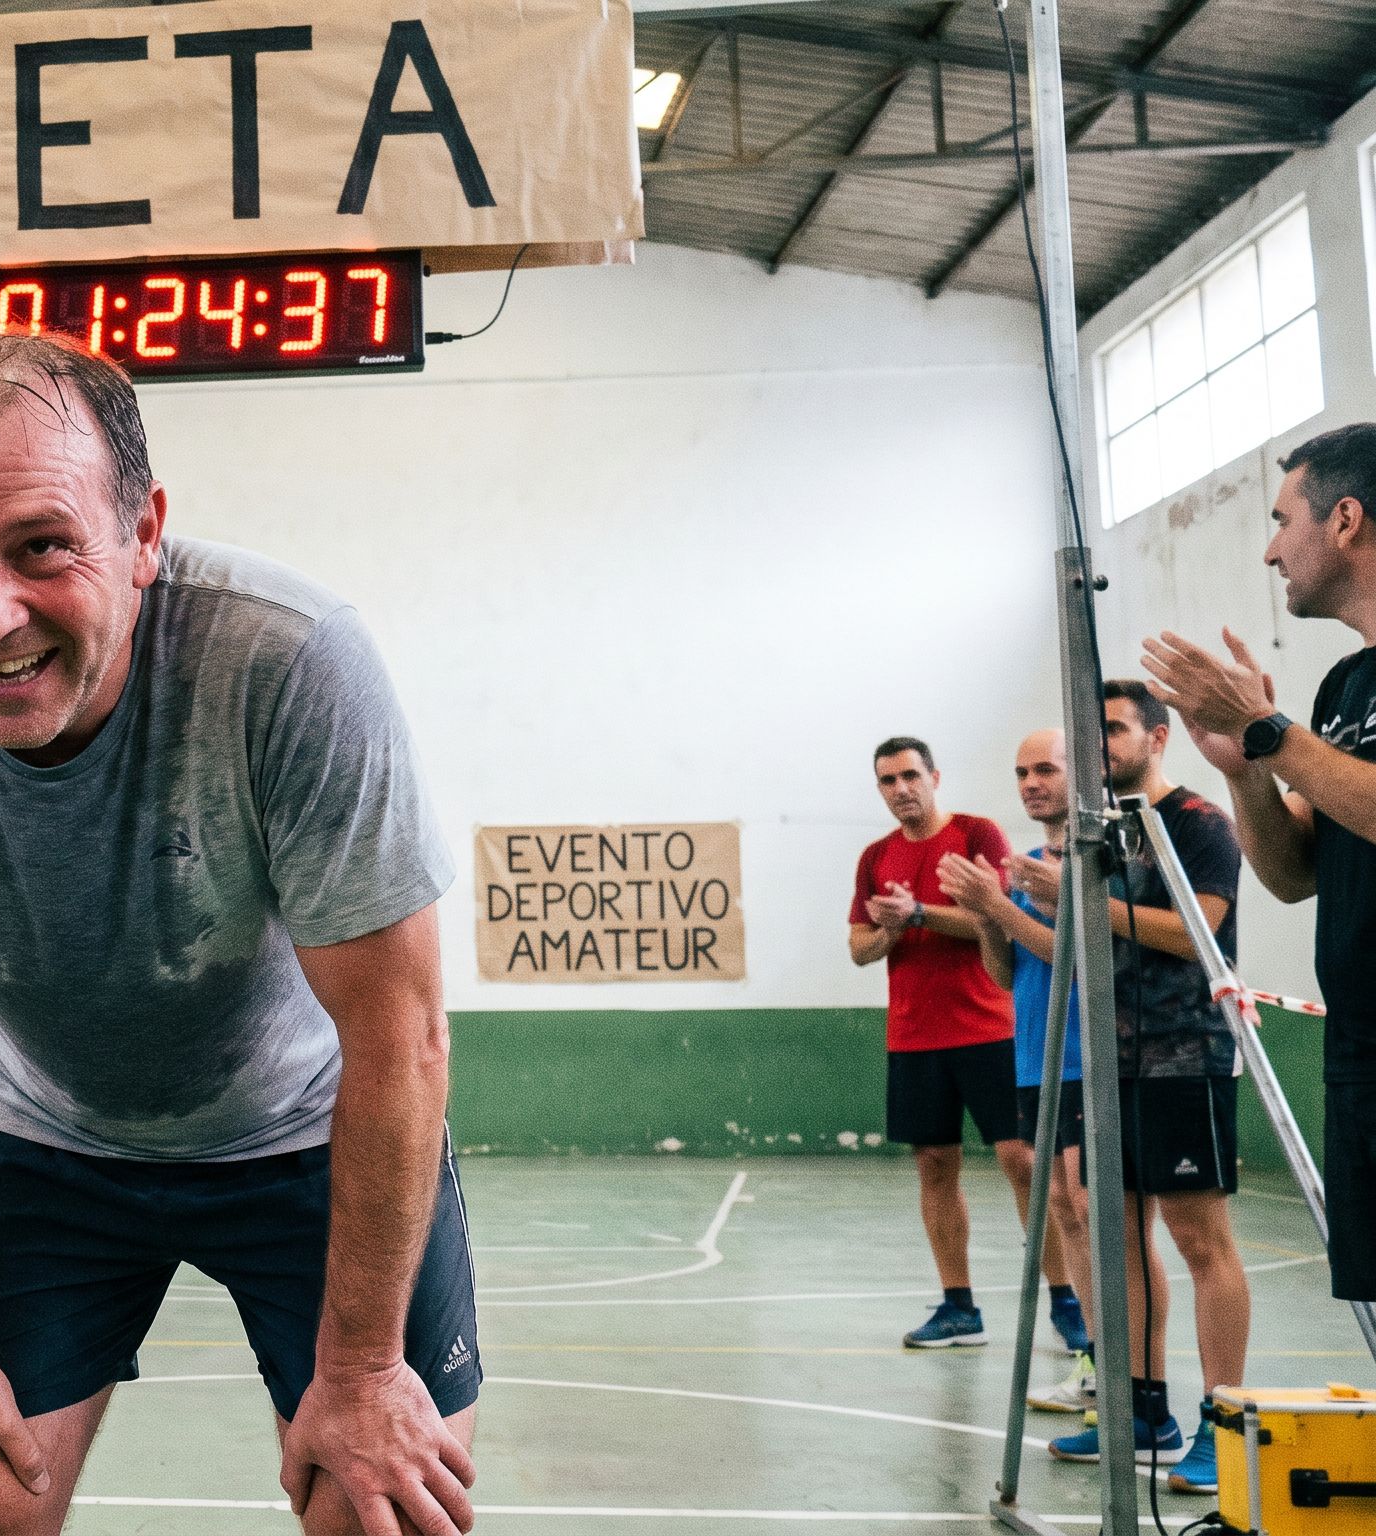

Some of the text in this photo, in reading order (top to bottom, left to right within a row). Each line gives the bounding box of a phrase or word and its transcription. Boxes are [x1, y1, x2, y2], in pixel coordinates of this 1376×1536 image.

[507, 831, 694, 873] EVENTO
[487, 879, 729, 922] DEPORTIVO
[508, 927, 719, 972] AMATEUR
